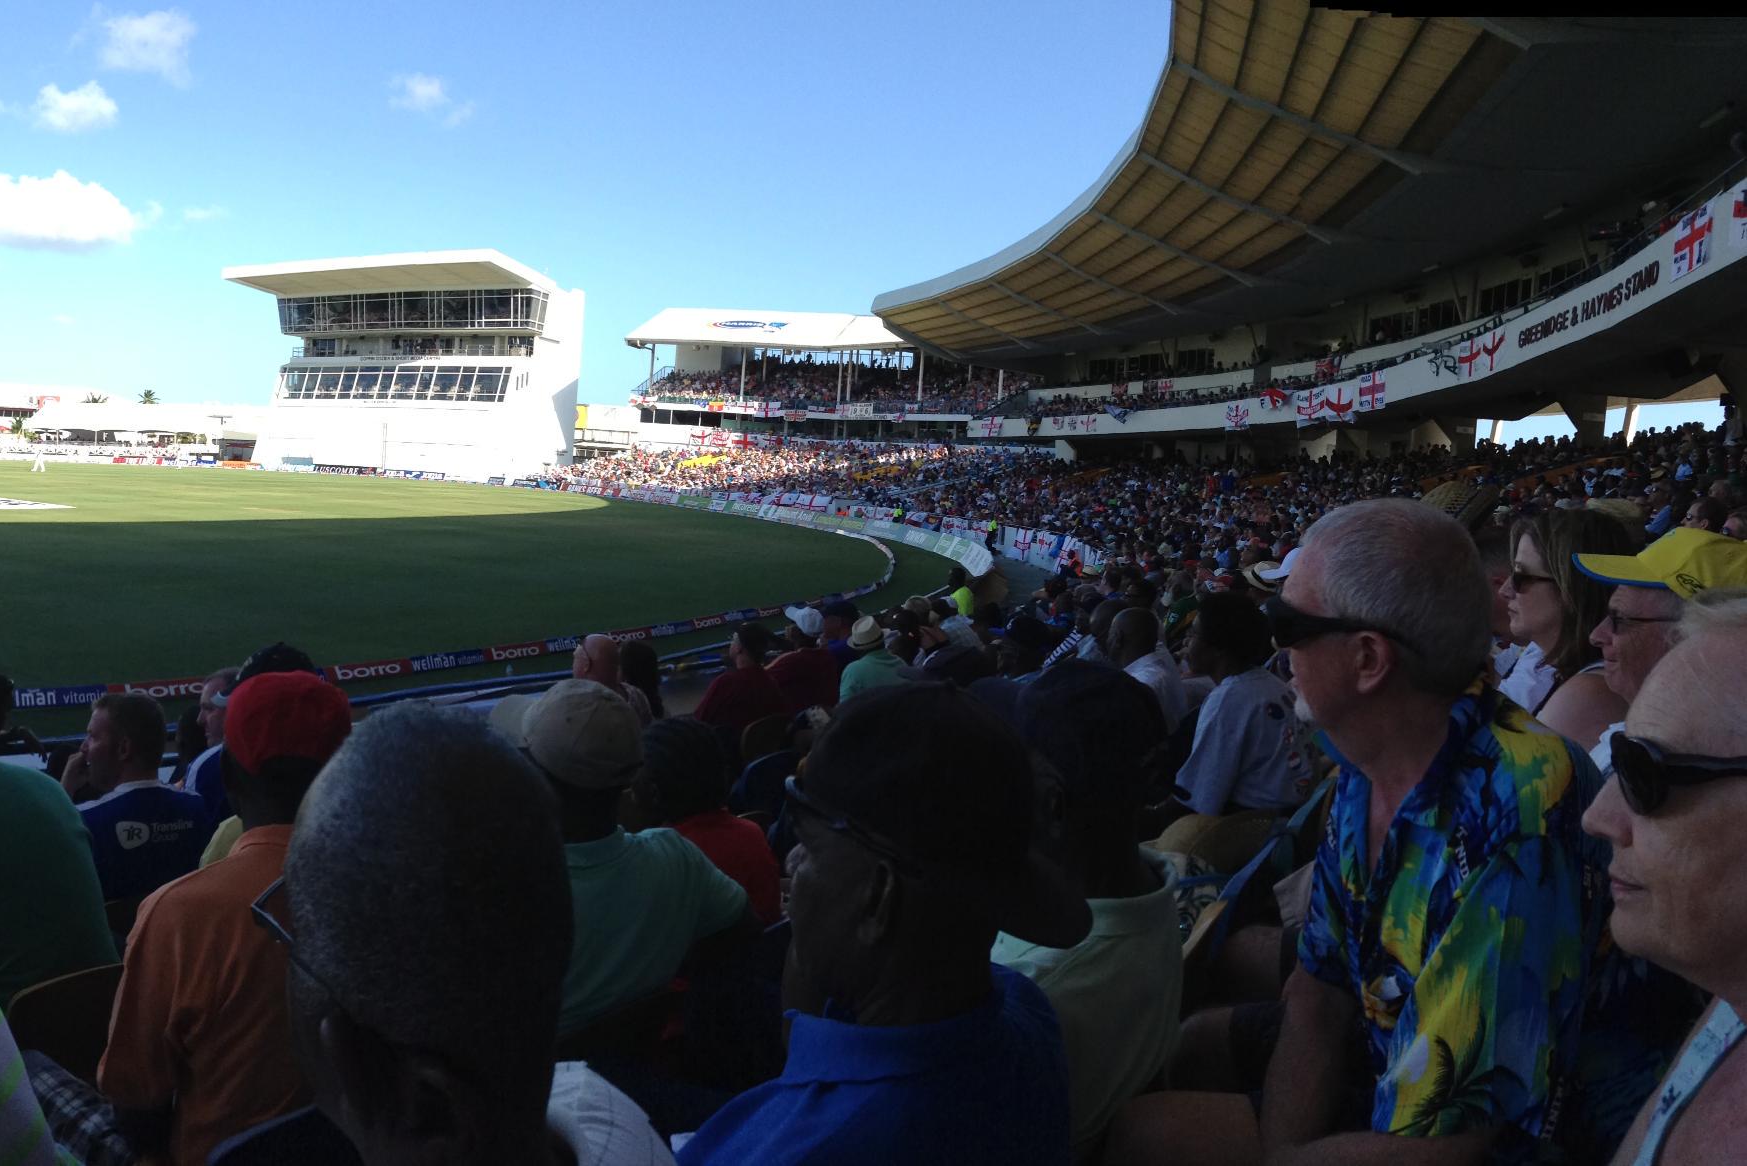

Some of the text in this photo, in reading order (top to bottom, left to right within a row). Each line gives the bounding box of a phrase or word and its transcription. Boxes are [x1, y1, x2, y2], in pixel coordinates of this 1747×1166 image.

[1518, 260, 1660, 348] GREENIDGE & HAYNES STAND
[314, 466, 359, 476] LUSCOMBE
[695, 616, 722, 629] borro
[608, 629, 646, 643] borro
[491, 644, 540, 661] borro
[335, 661, 401, 681] borro
[411, 652, 485, 673] wellman vitamin
[14, 688, 57, 708] lman
[152, 819, 195, 833] Transline
